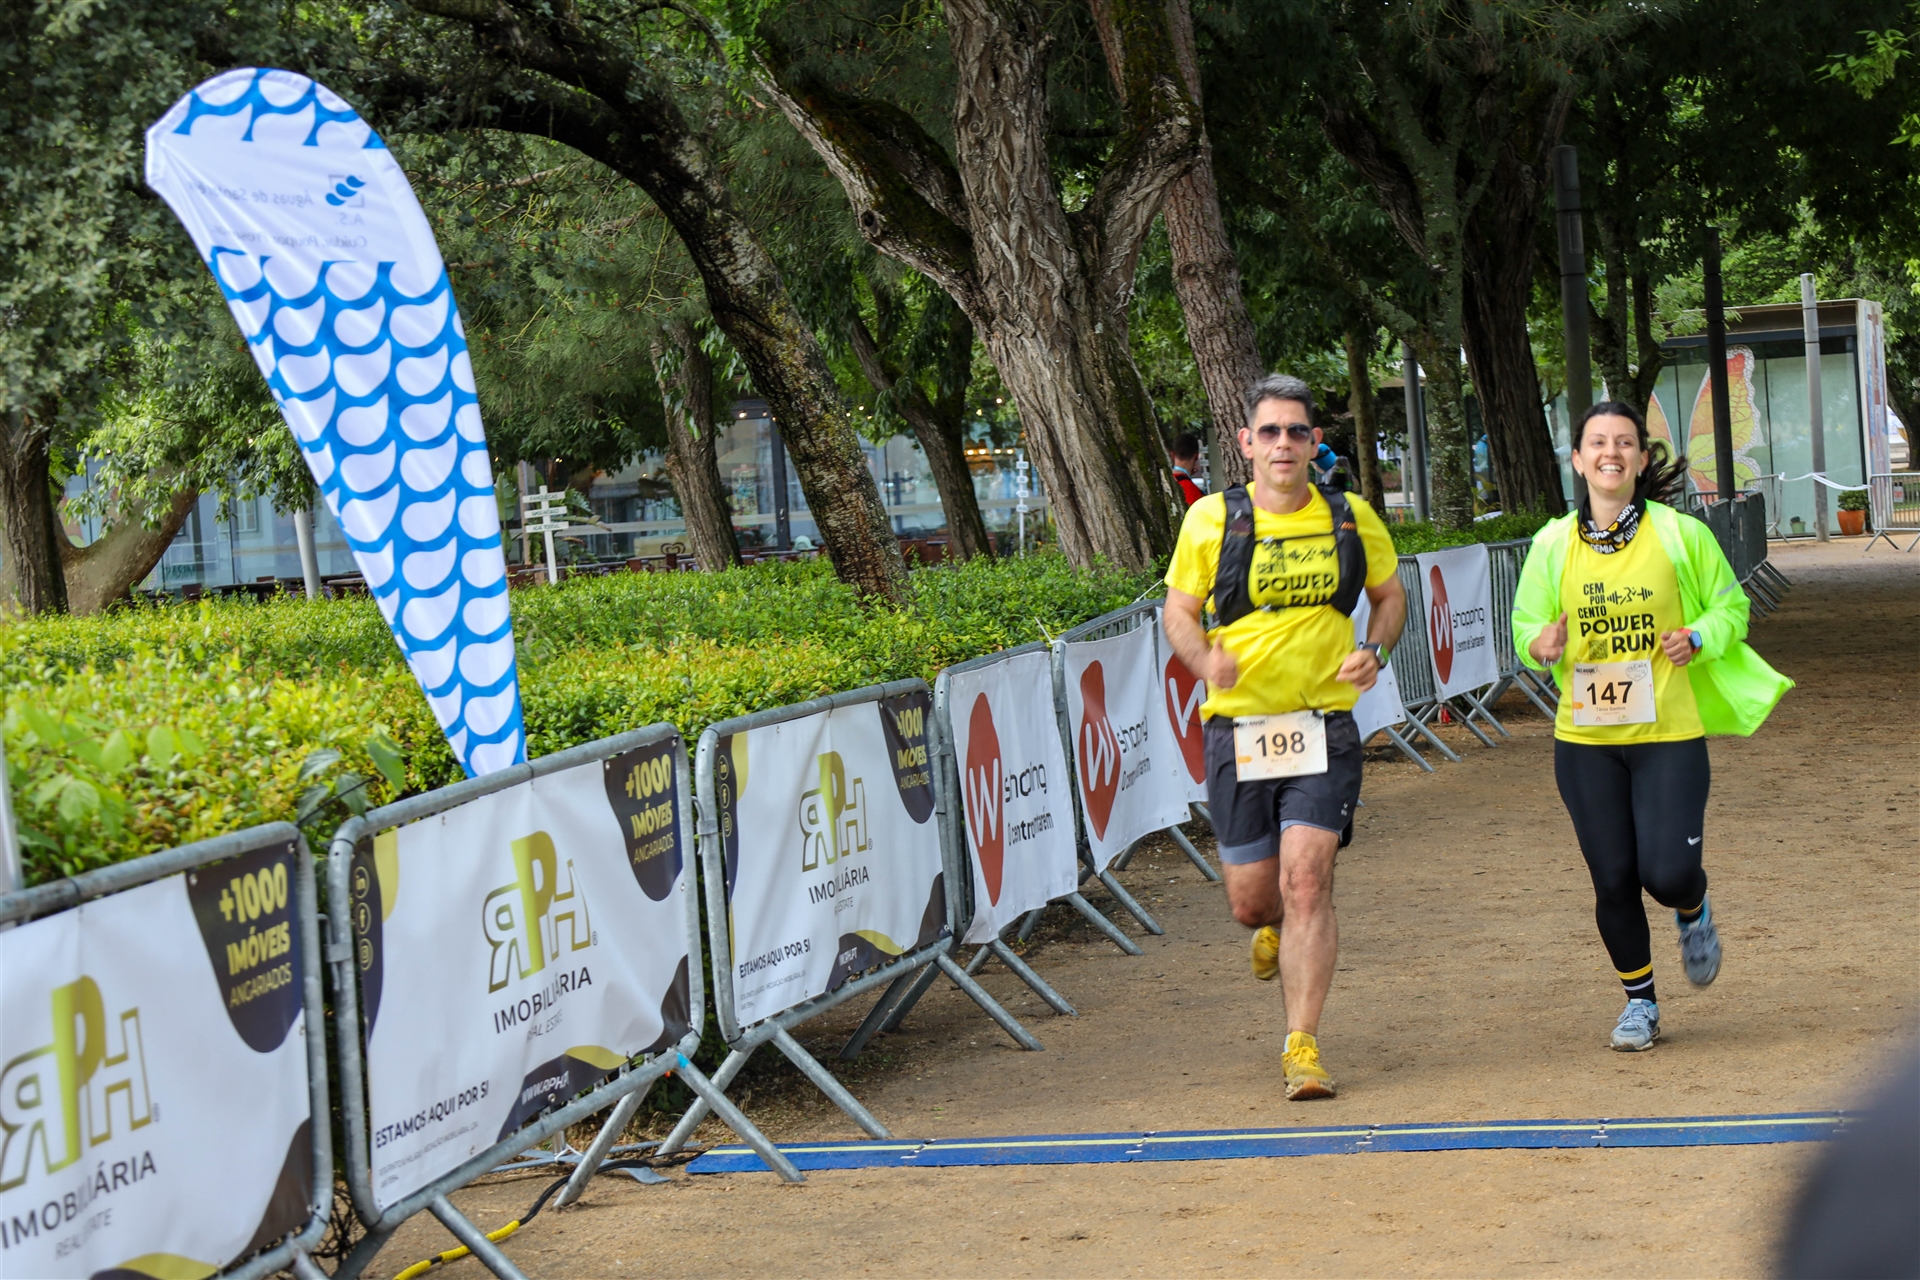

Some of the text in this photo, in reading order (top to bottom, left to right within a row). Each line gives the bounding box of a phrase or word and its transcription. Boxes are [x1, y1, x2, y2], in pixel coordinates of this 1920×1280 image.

[1257, 572, 1335, 594] POWER
[1583, 582, 1605, 595] CEM
[1577, 605, 1607, 619] CENTO
[1589, 594, 1606, 605] POR
[1579, 613, 1655, 638] POWER
[1611, 632, 1655, 654] RUN
[1586, 680, 1633, 706] 147
[1255, 731, 1306, 758] 198
[625, 753, 672, 800] +1000
[630, 799, 674, 840] IMÓVEIS
[633, 831, 675, 865] ANGARIADOS
[219, 862, 288, 924] +1000
[226, 920, 291, 976] IMÓVEIS
[766, 947, 785, 966] AQUI
[784, 941, 804, 960] POR
[803, 938, 812, 953] SI
[229, 961, 293, 1008] ANGARIADOS
[494, 966, 593, 1035] IMOBILIÁRIA
[375, 1079, 490, 1150] ESTAMOS AQUI POR SI
[1, 1150, 157, 1250] IMOBILIÁRIA
